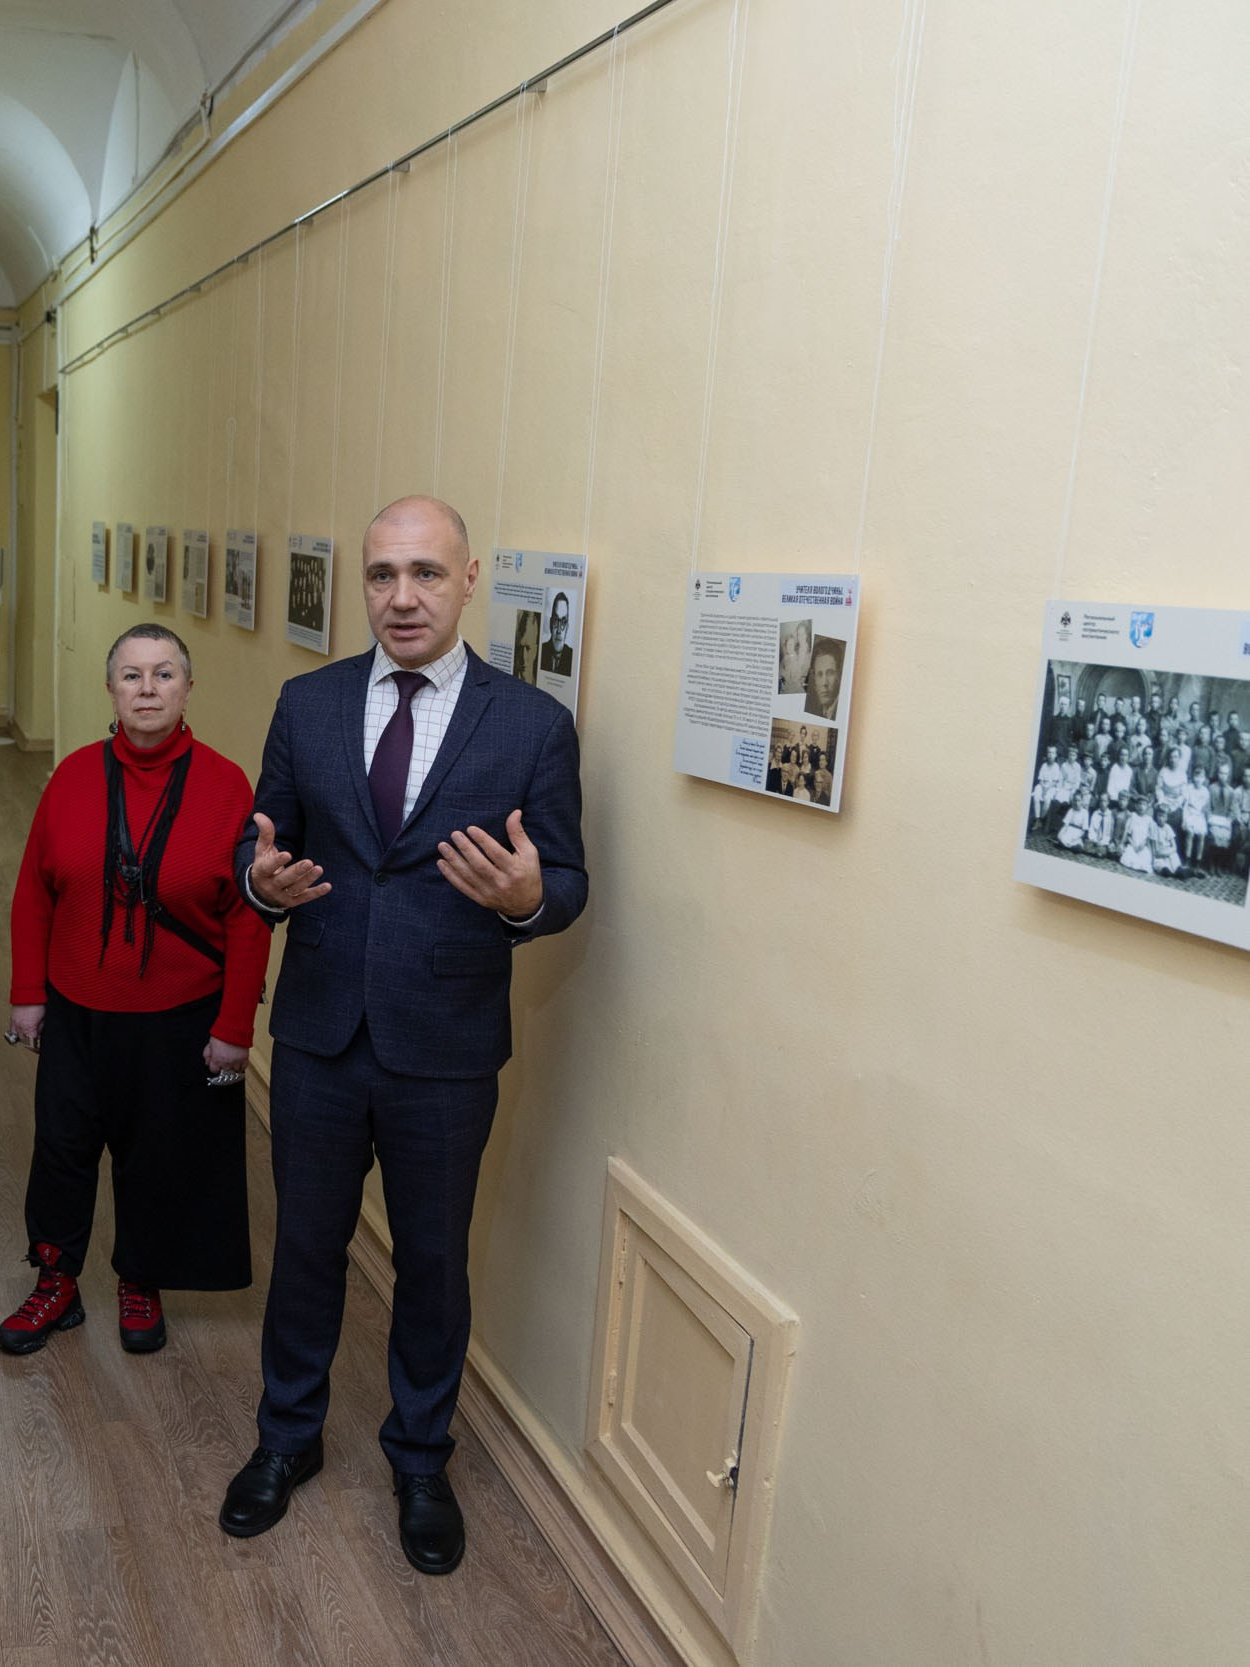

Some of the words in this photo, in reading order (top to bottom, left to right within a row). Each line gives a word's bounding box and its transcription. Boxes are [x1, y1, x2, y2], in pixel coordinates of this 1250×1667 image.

[782, 595, 798, 603] ВЕЛИКАЯ
[799, 595, 830, 605] ОТЕЧЕСТВЕННАЯ
[830, 597, 843, 605] ВОЙНА
